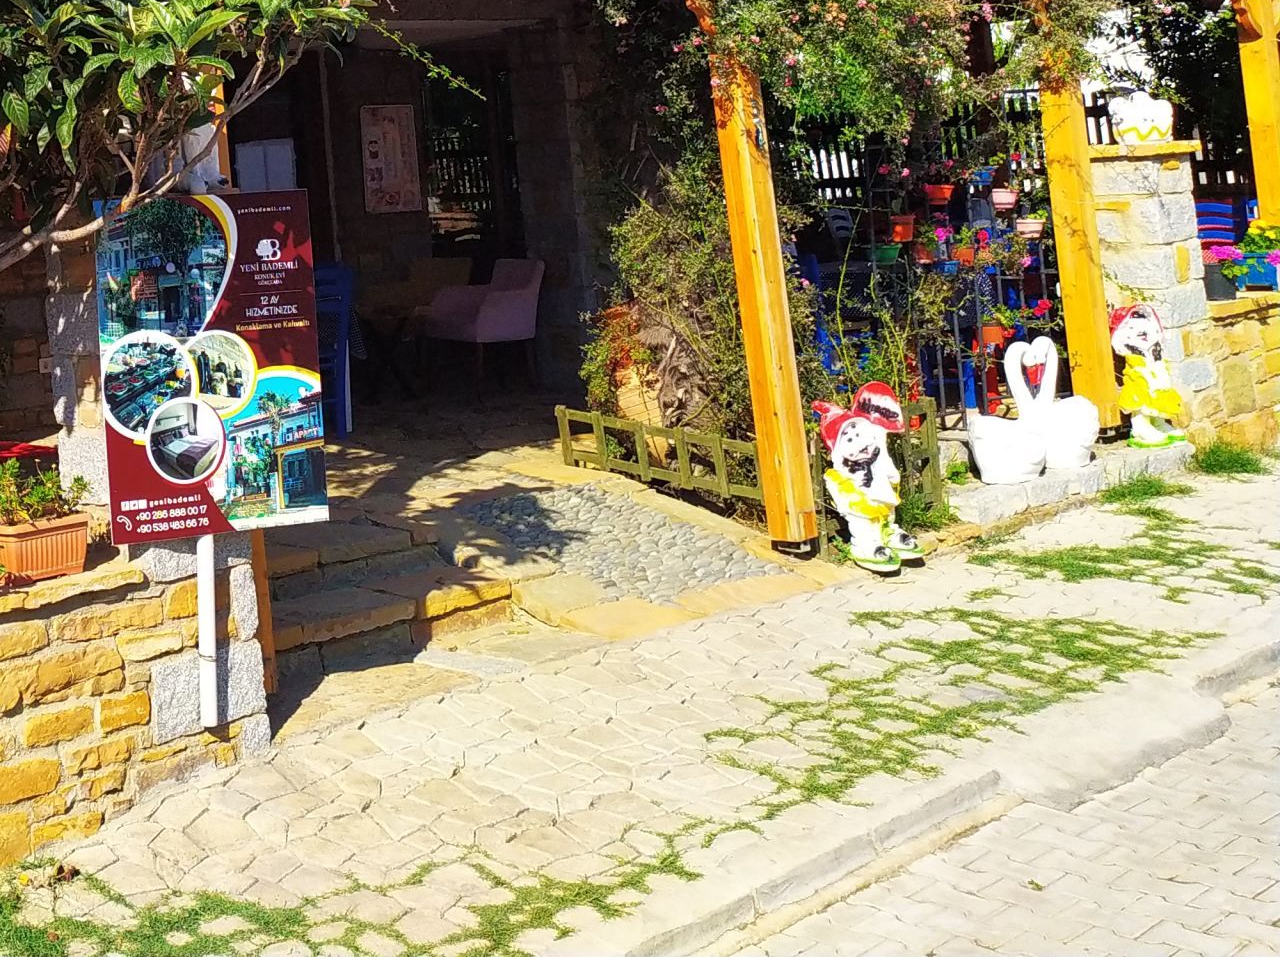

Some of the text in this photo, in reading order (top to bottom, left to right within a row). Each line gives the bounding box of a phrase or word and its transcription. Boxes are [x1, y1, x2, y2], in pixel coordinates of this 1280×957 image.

[237, 206, 292, 215] yenibademli.com
[240, 259, 298, 273] YENİ BADEMLİ
[260, 294, 280, 305] 12 AY
[235, 322, 273, 332] Konaklama
[282, 319, 310, 328] Kahvaltı
[149, 493, 201, 508] yenibademli
[135, 505, 208, 521] +90 286 888 00 17
[136, 517, 209, 534] +90 538 483 66 76
